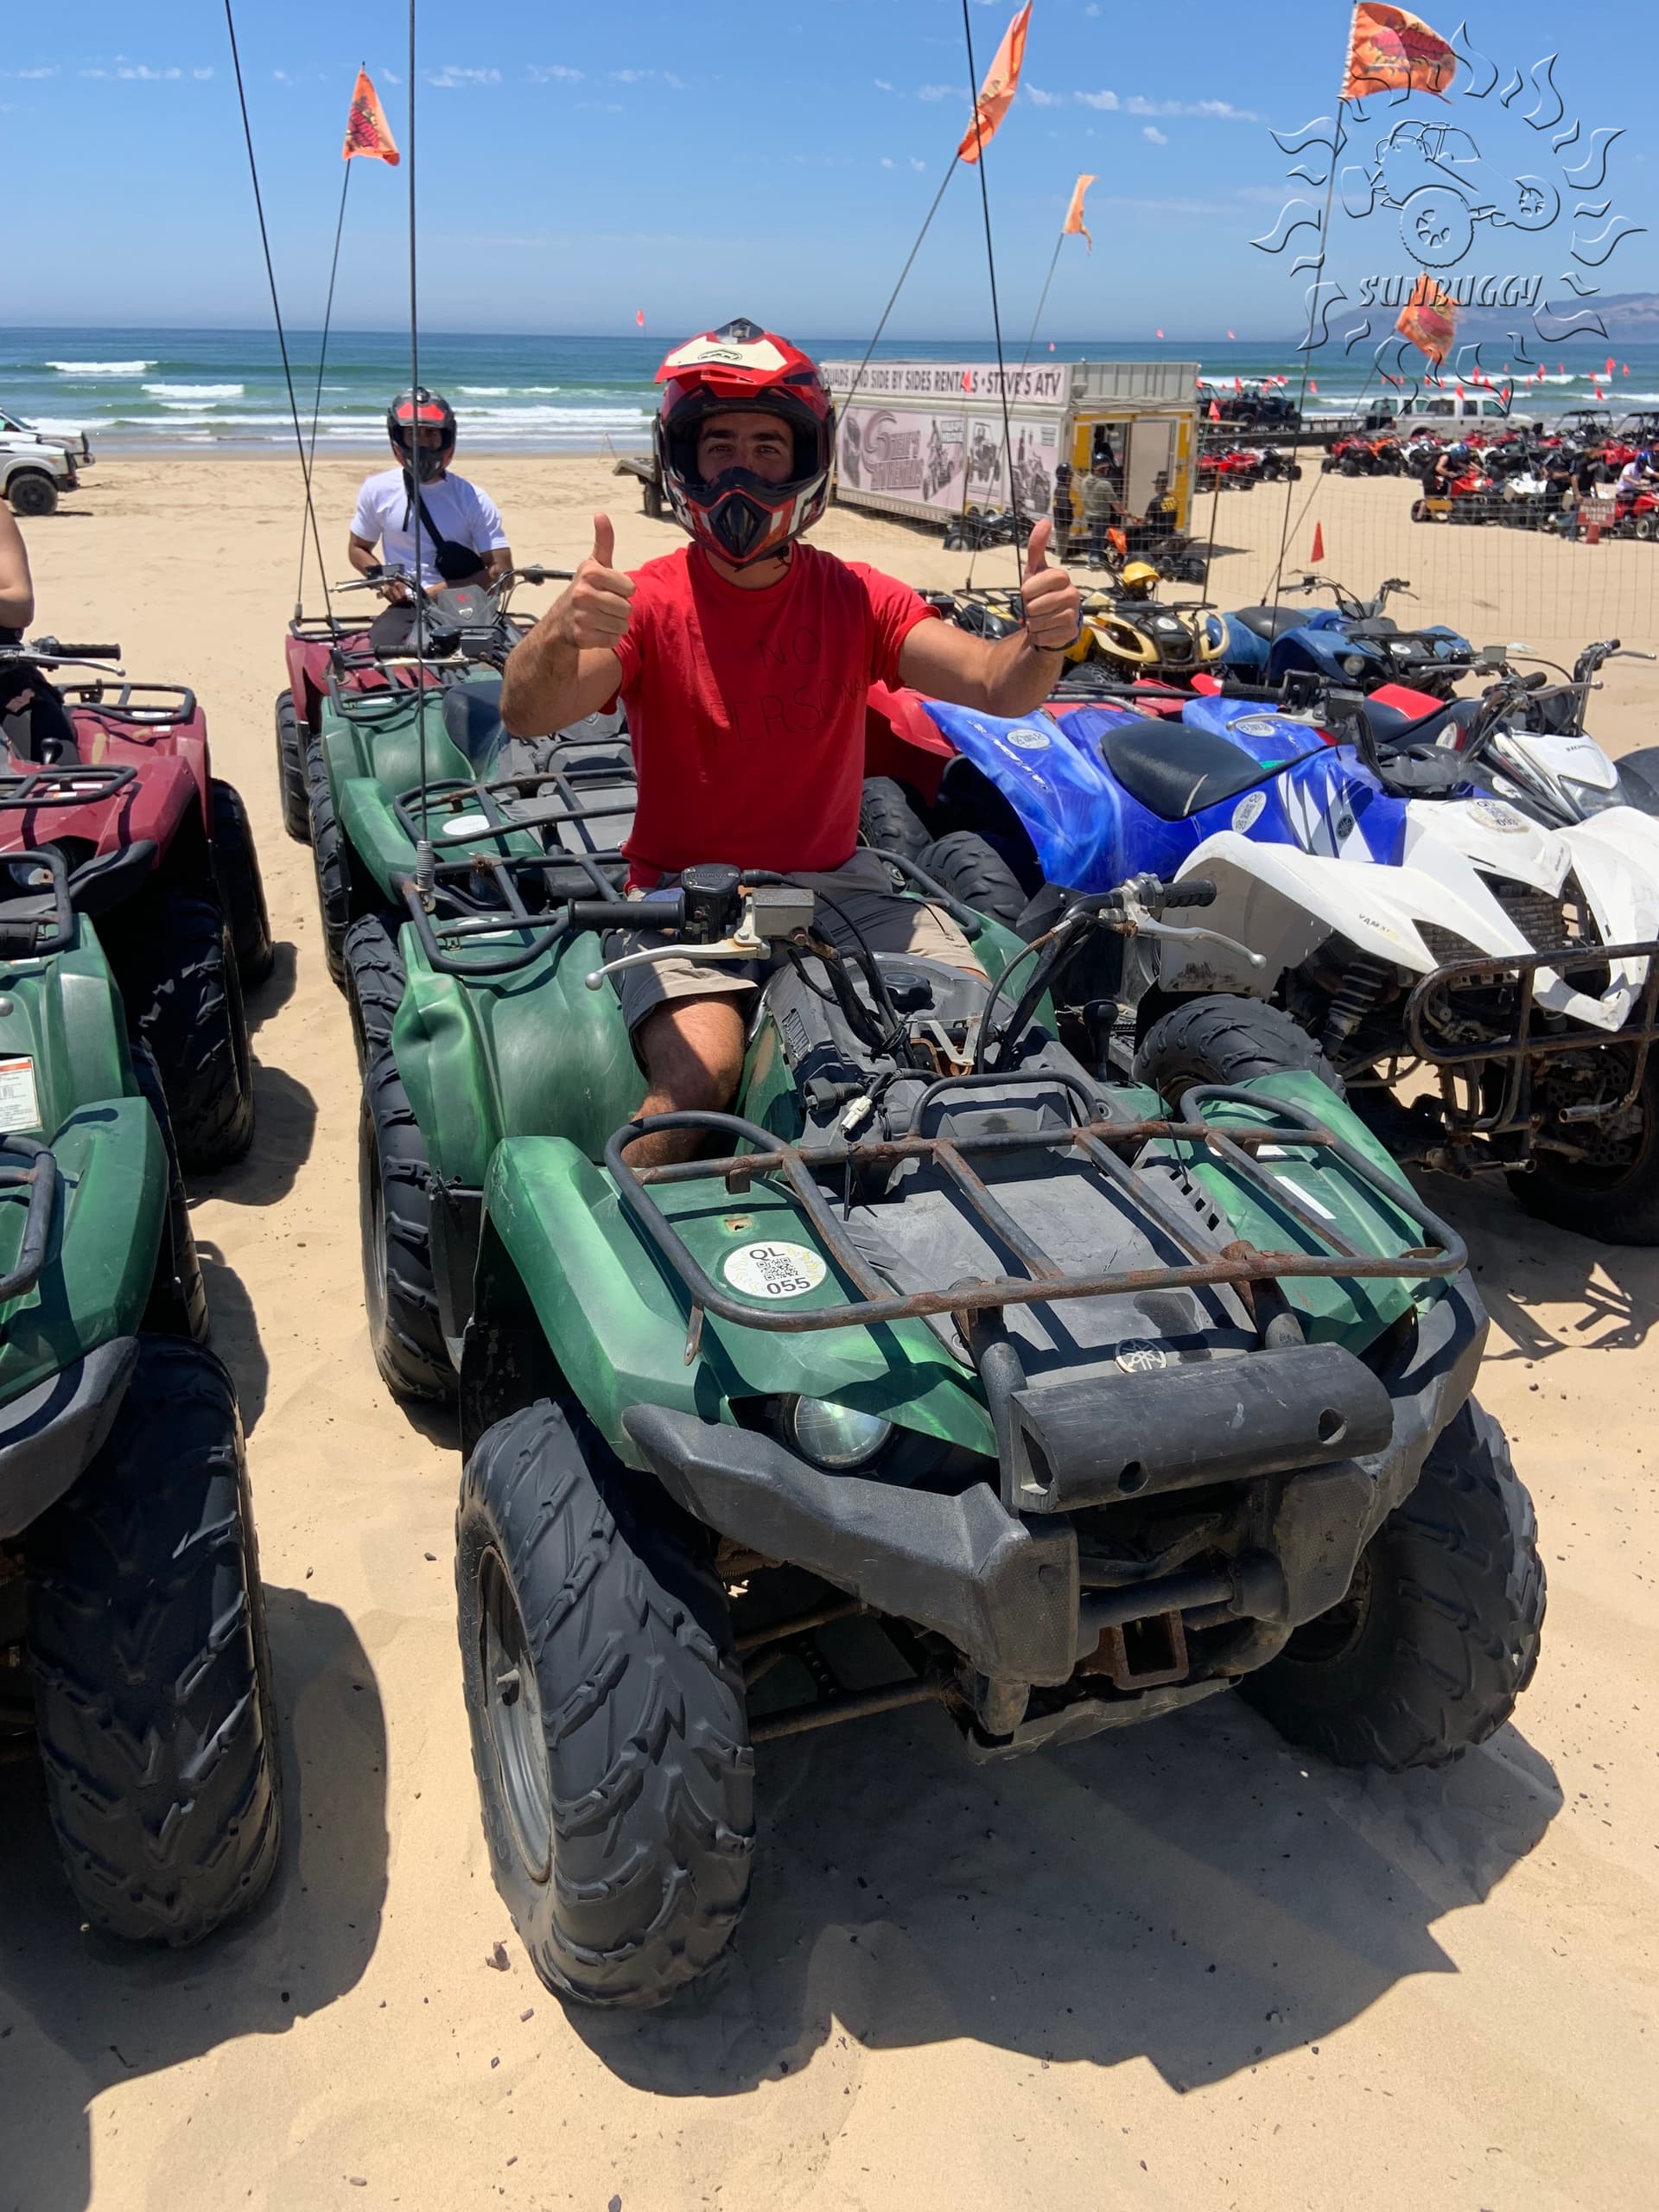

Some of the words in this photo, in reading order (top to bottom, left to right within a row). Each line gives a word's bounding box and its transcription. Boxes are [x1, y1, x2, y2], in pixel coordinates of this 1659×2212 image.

[870, 370, 890, 390] SIDE
[892, 371, 904, 390] BY
[905, 371, 931, 391] SIDES
[1034, 372, 1062, 397] ATV
[757, 626, 820, 670] NO
[749, 1247, 785, 1262] QL
[766, 1276, 810, 1295] 055
